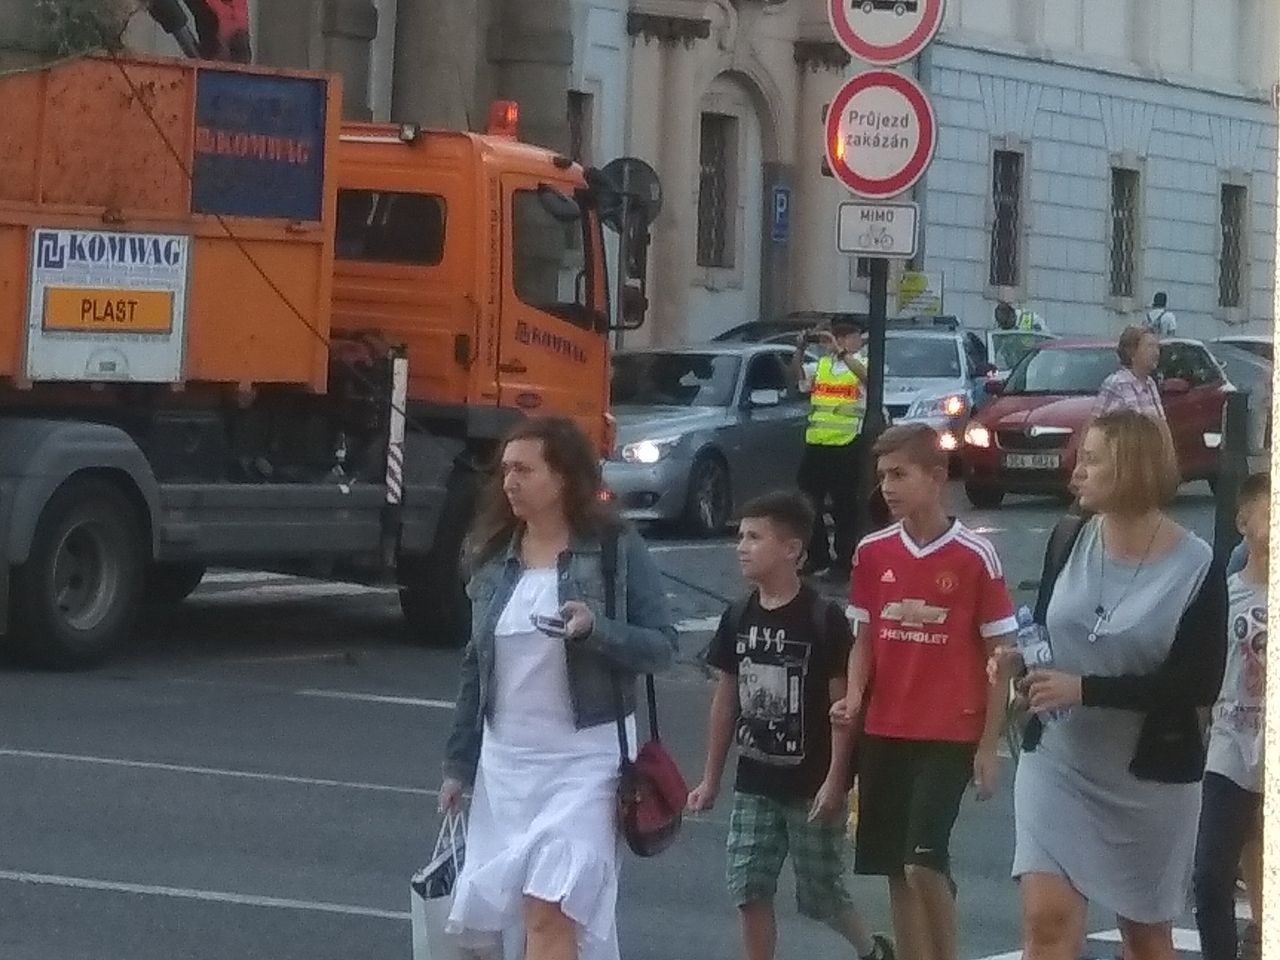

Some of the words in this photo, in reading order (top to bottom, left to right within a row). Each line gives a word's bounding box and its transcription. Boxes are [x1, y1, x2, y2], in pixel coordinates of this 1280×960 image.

[849, 110, 909, 129] Průjezd
[846, 132, 909, 149] zakázán
[776, 192, 788, 224] P
[860, 210, 894, 223] MIMO
[69, 234, 181, 266] KOMWAG
[80, 298, 138, 323] PLAST
[749, 626, 785, 653] NYC
[880, 628, 949, 645] CHEVROLET
